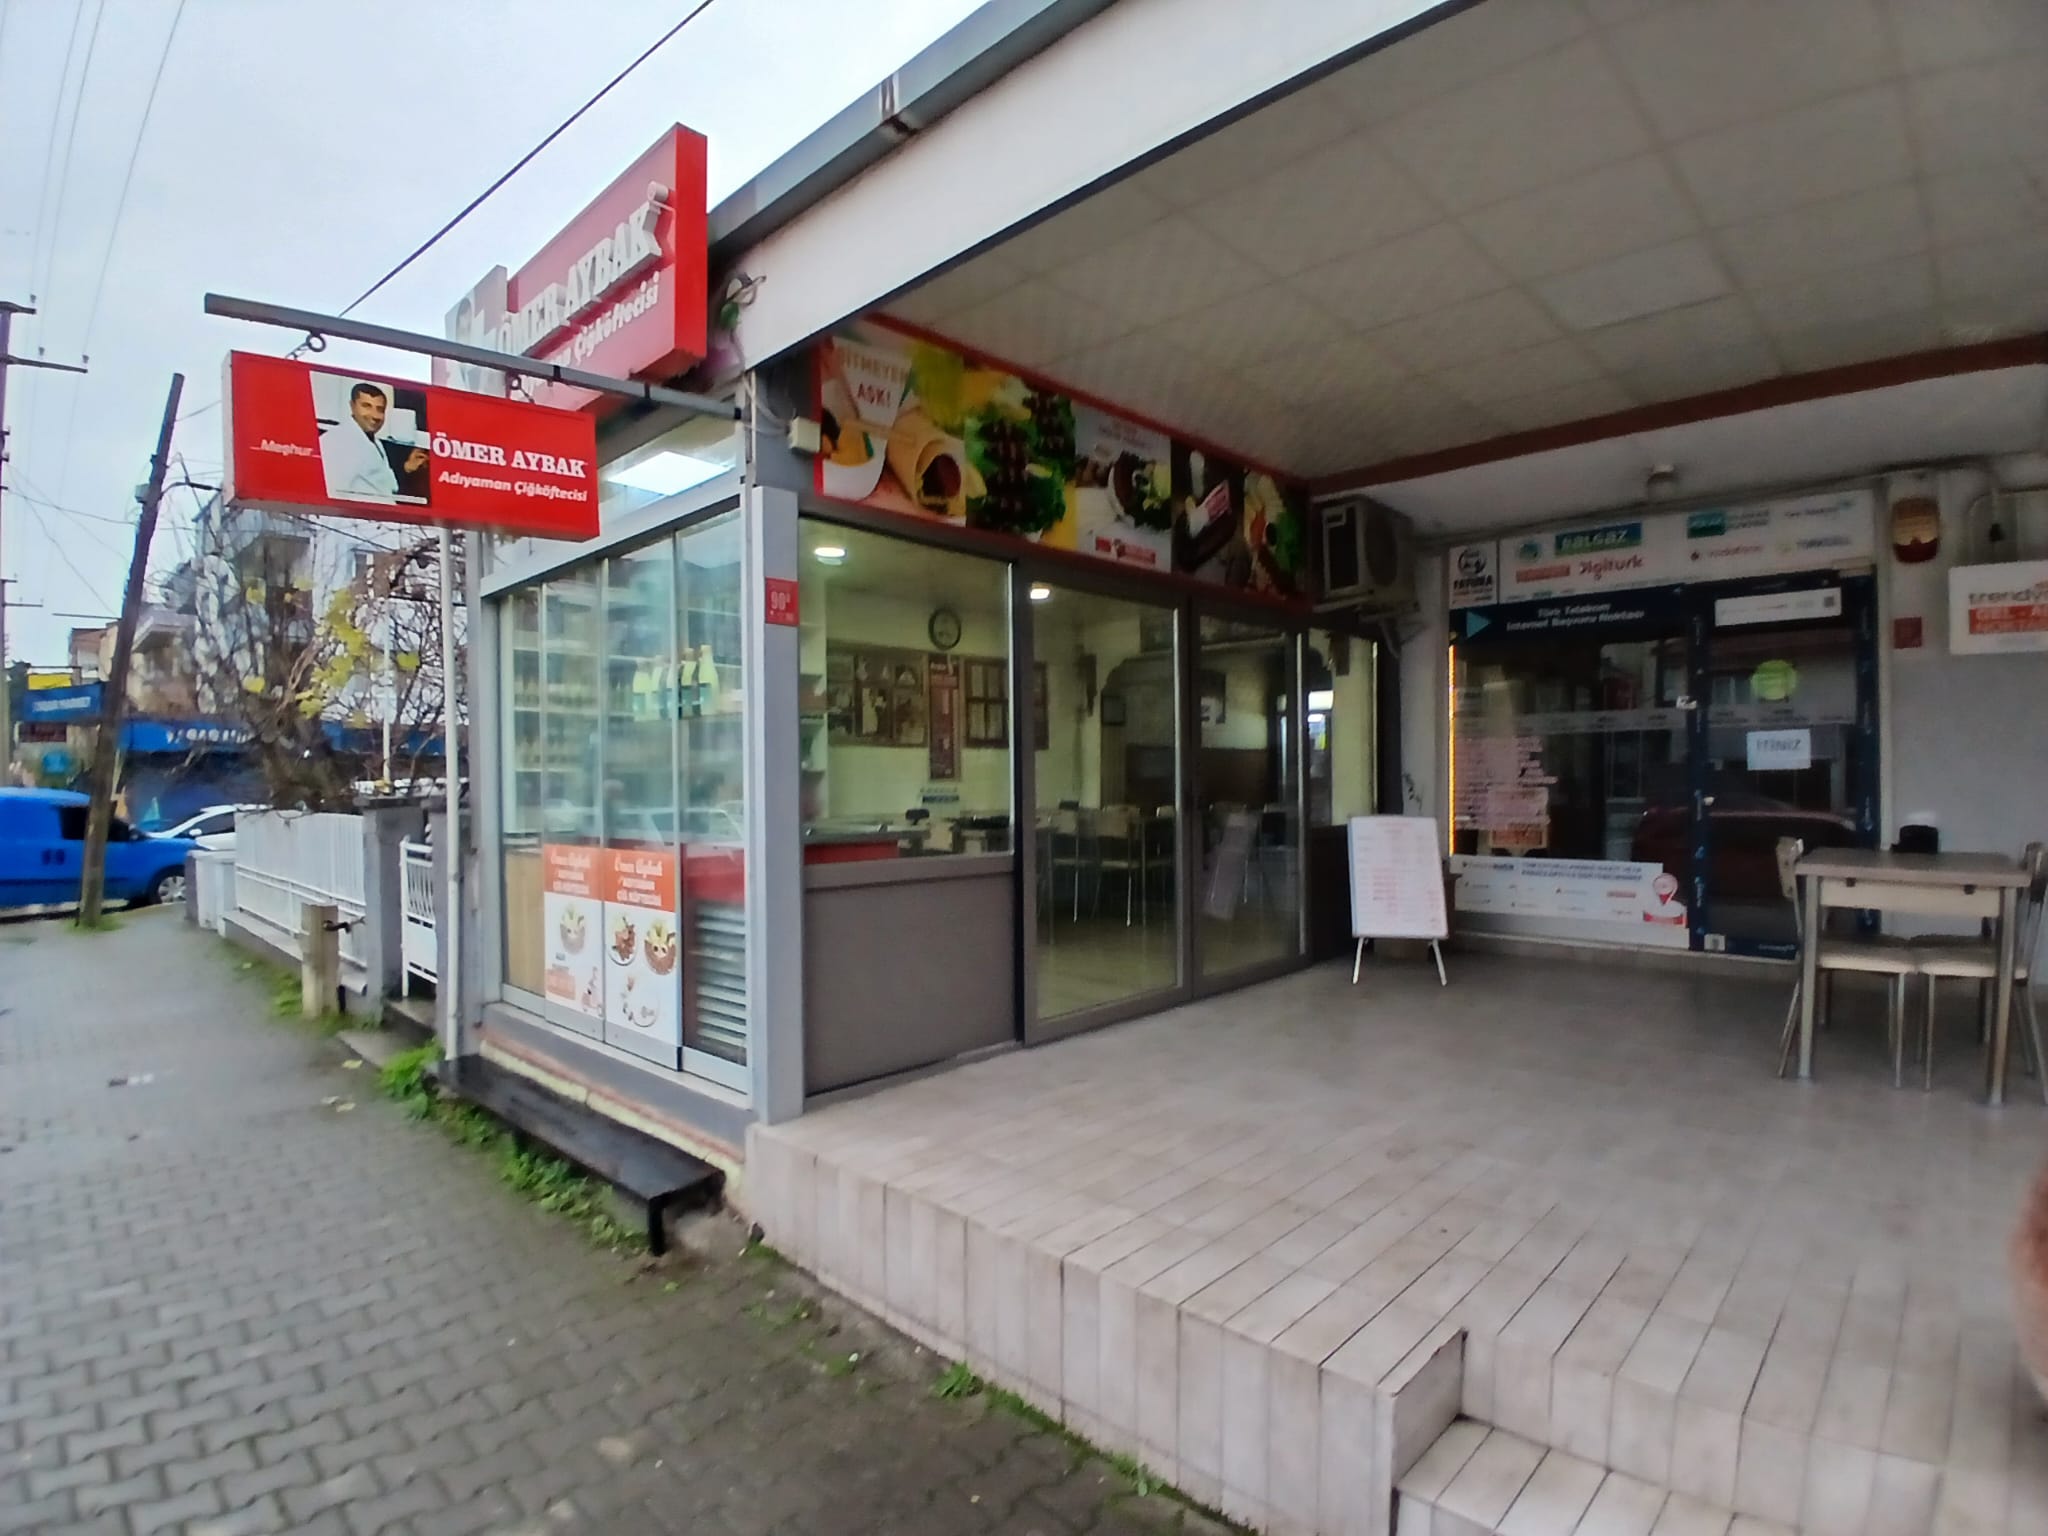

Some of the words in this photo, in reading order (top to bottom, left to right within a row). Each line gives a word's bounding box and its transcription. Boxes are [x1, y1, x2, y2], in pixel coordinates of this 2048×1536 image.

[565, 201, 663, 321] AYBAK
[432, 431, 507, 467] ÖMER
[511, 450, 588, 479] AYBAK
[438, 470, 512, 493] Adıyaman
[514, 480, 588, 502] Çiğköftecisi
